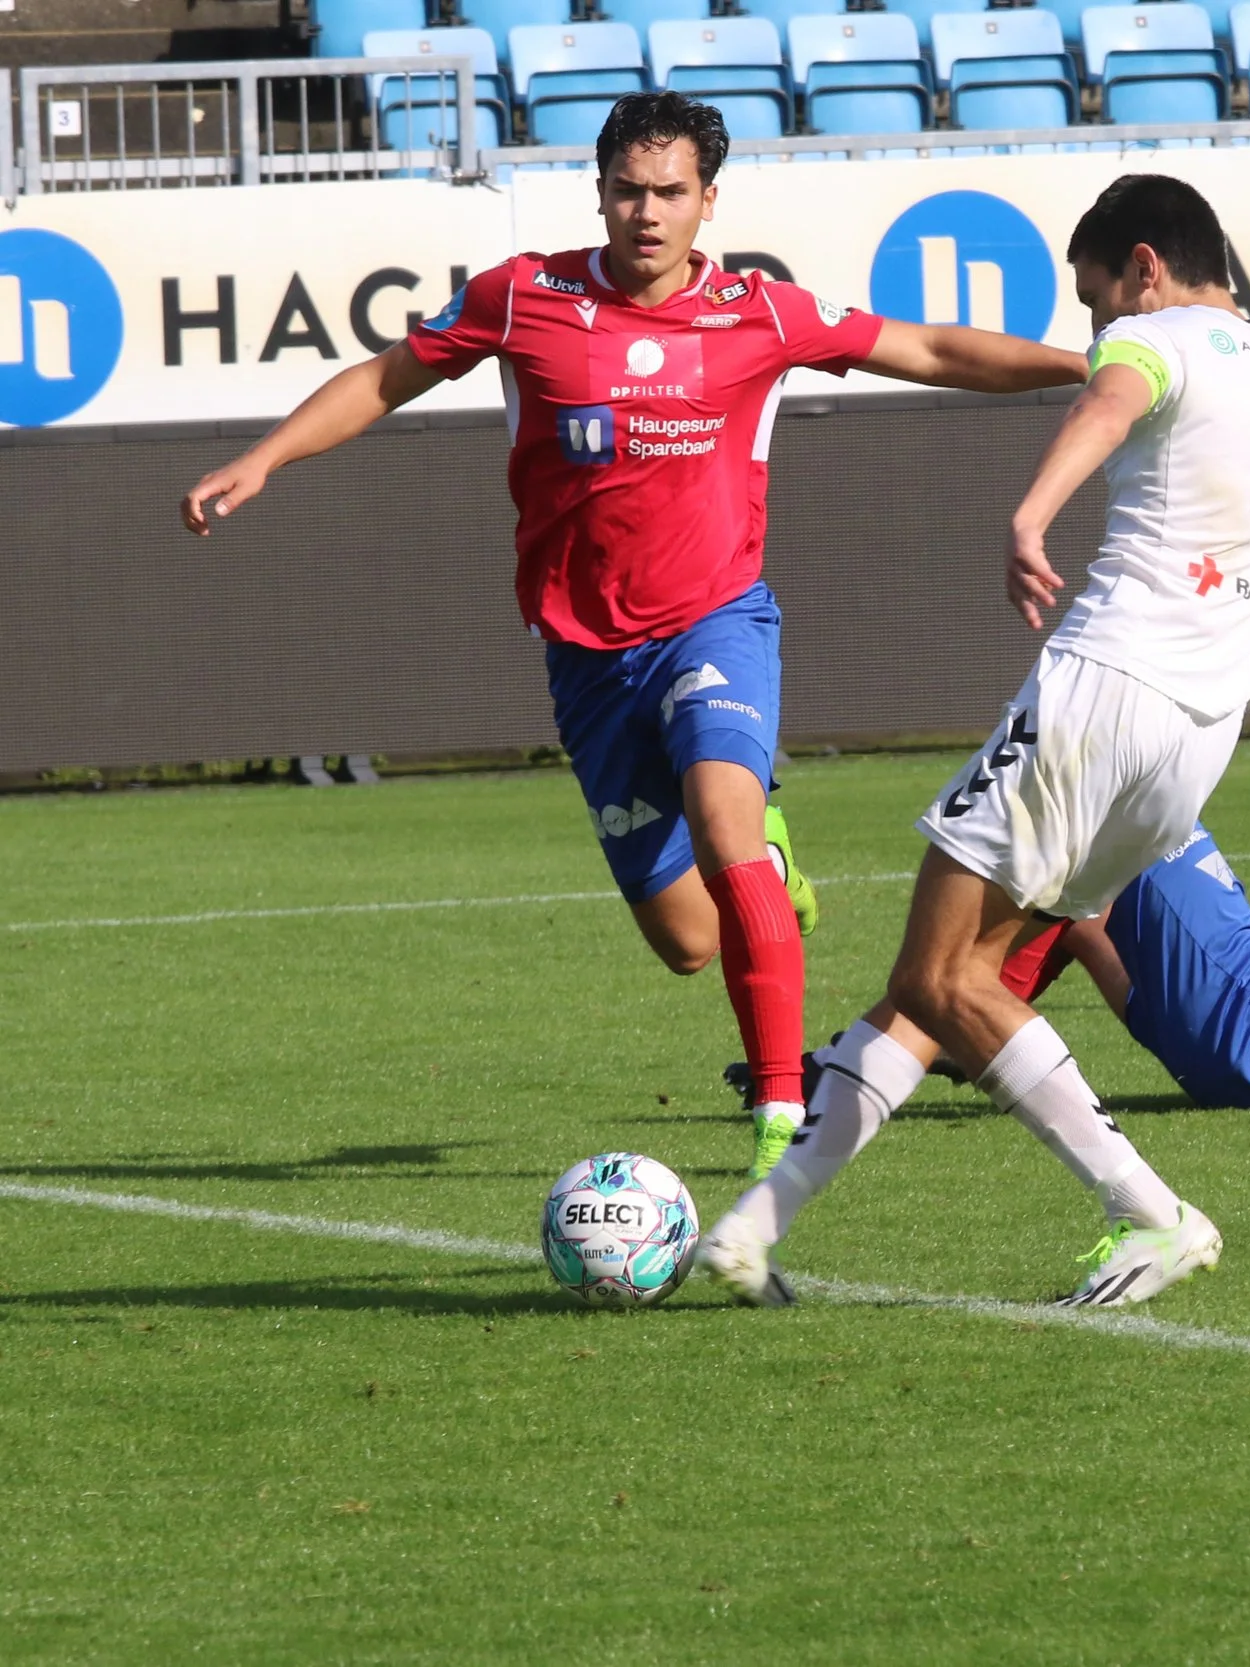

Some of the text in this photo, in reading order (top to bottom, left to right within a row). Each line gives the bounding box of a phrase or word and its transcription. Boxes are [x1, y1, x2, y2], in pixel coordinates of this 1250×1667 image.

[58, 109, 70, 127] 3
[628, 412, 727, 434] Haugesund
[627, 435, 717, 460] Sparebank
[707, 699, 762, 722] macron
[565, 1203, 646, 1227] SELECT
